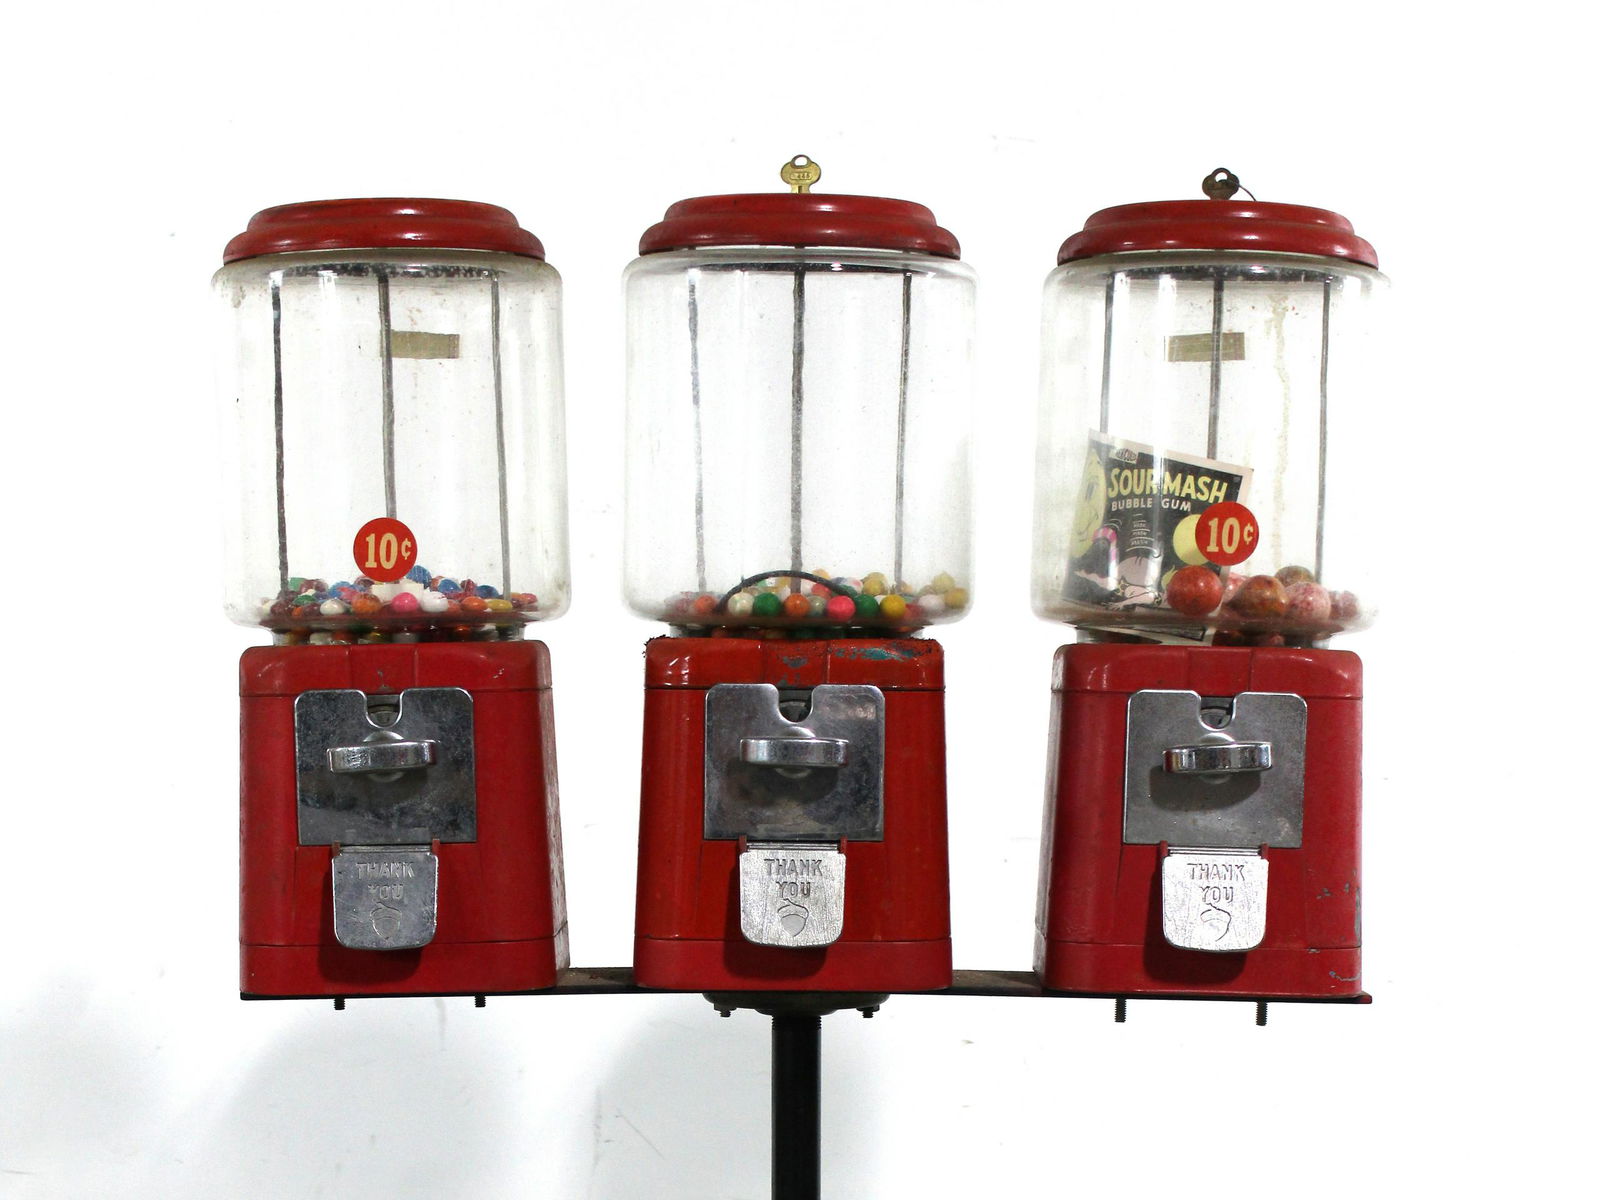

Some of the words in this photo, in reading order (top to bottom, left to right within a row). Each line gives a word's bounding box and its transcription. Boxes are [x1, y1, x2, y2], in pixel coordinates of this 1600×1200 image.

[1108, 467, 1159, 498] SOUR
[1163, 472, 1228, 504] MASH
[1111, 497, 1153, 512] BUBBLE
[1161, 498, 1191, 512] GUM
[1206, 517, 1254, 554] 10¢
[365, 532, 412, 570] 10¢
[356, 861, 415, 879] THANK
[763, 858, 823, 876] THANK
[1186, 863, 1245, 881] THANK
[367, 884, 404, 901] YOU
[775, 881, 811, 898] YOU
[1200, 885, 1234, 903] YOU
